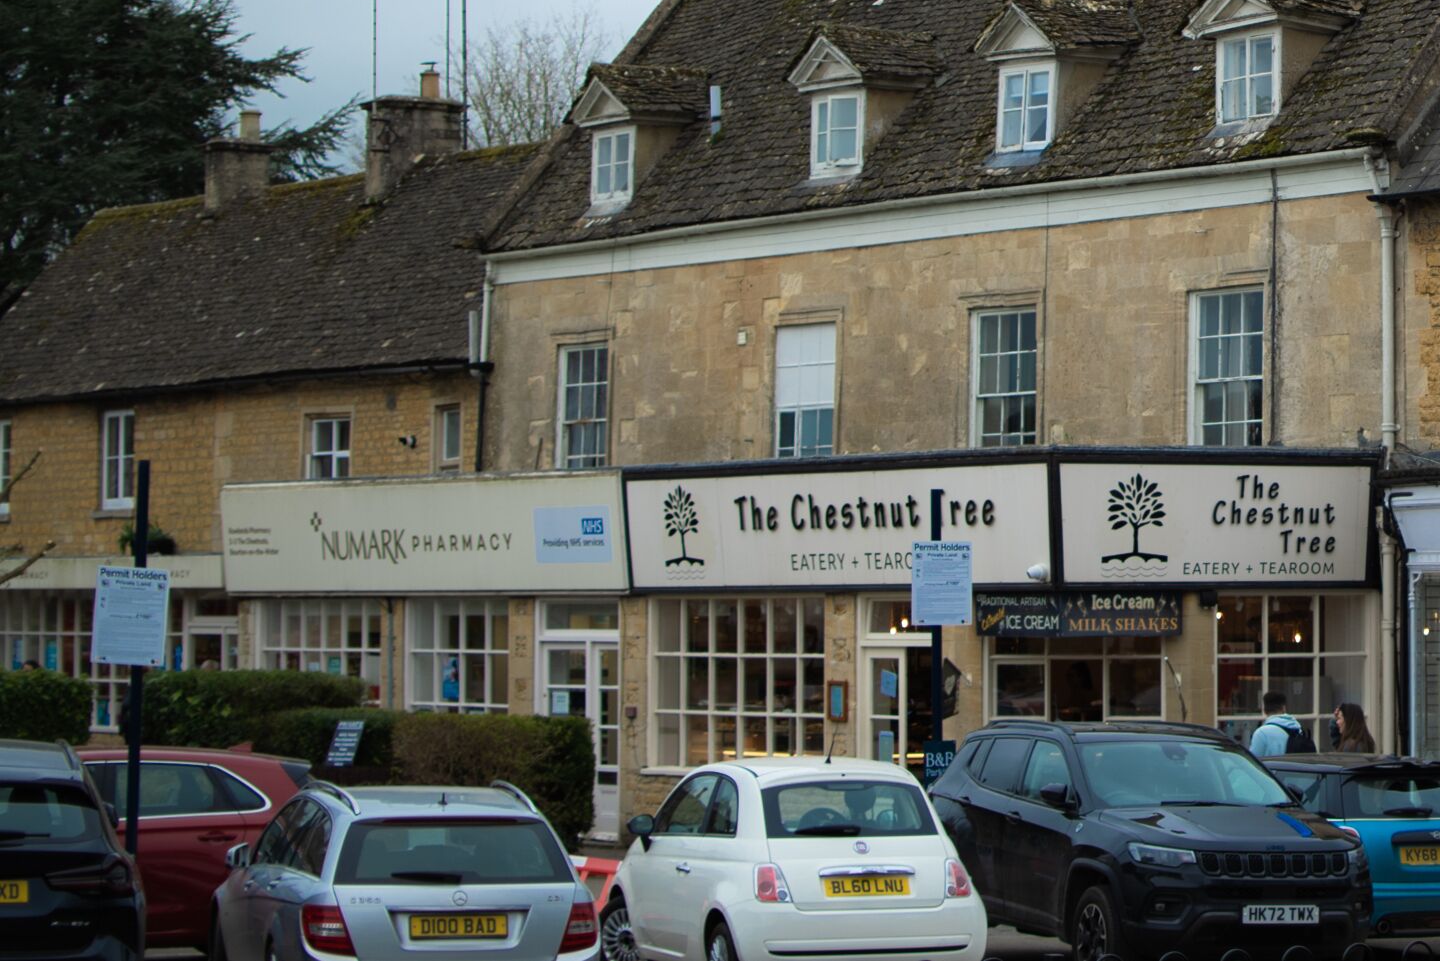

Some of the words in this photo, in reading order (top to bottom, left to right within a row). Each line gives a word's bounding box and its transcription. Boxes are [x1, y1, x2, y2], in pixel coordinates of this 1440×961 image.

[1236, 474, 1280, 500] The
[733, 495, 779, 532] The
[790, 493, 920, 531] Chestnut
[1212, 499, 1336, 526] Chestnut
[583, 519, 602, 534] NHS
[321, 529, 407, 564] NUMARK
[411, 532, 513, 553] PHARMACY
[543, 538, 569, 550] Providing
[914, 543, 940, 552] Permit
[940, 543, 970, 552] Holders
[1279, 529, 1336, 555] Tree
[791, 552, 846, 572] EATERY
[851, 558, 859, 568] +
[864, 552, 912, 571] TEARO
[1183, 562, 1240, 576] EATERY
[1246, 565, 1253, 574] +
[1260, 561, 1335, 576] TEAROOM
[100, 567, 130, 579] Permit
[132, 569, 168, 582] Holders
[977, 594, 1019, 607] TRADITIONAL
[1091, 594, 1111, 610] Ice
[1112, 594, 1155, 610] Cream
[1006, 614, 1023, 630] ICE
[1023, 614, 1060, 631] CREAM
[1069, 617, 1114, 634] MILK
[1115, 617, 1179, 633] SHAKES
[1406, 847, 1437, 862] KY68
[831, 879, 871, 895] BL60
[874, 879, 904, 894] LNU
[1248, 907, 1285, 922] HK72
[1288, 906, 1315, 922] TWX
[420, 918, 459, 935] D100
[463, 917, 497, 934] BAD
